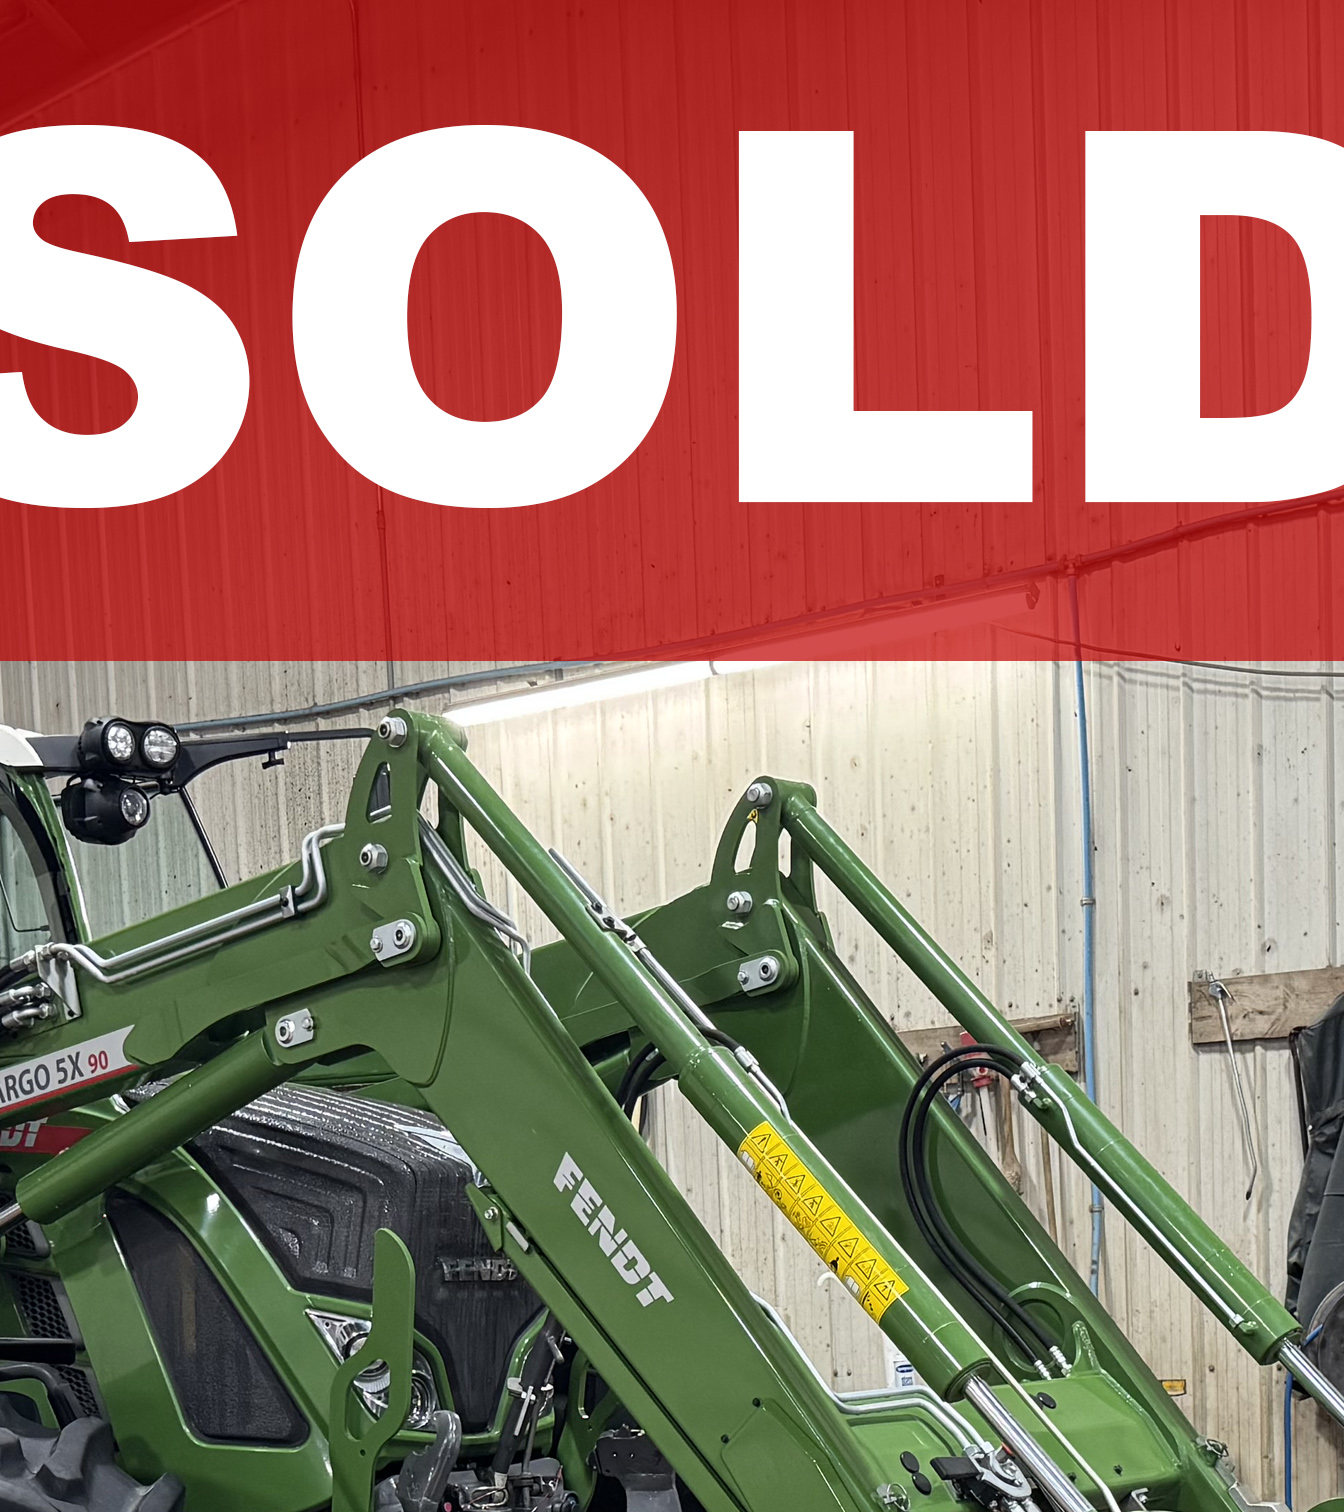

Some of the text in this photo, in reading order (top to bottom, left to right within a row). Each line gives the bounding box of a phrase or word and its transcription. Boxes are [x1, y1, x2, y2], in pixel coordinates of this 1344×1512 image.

[56, 1051, 84, 1085] 5X
[88, 1050, 109, 1074] 90
[553, 1151, 675, 1308] FENDT
